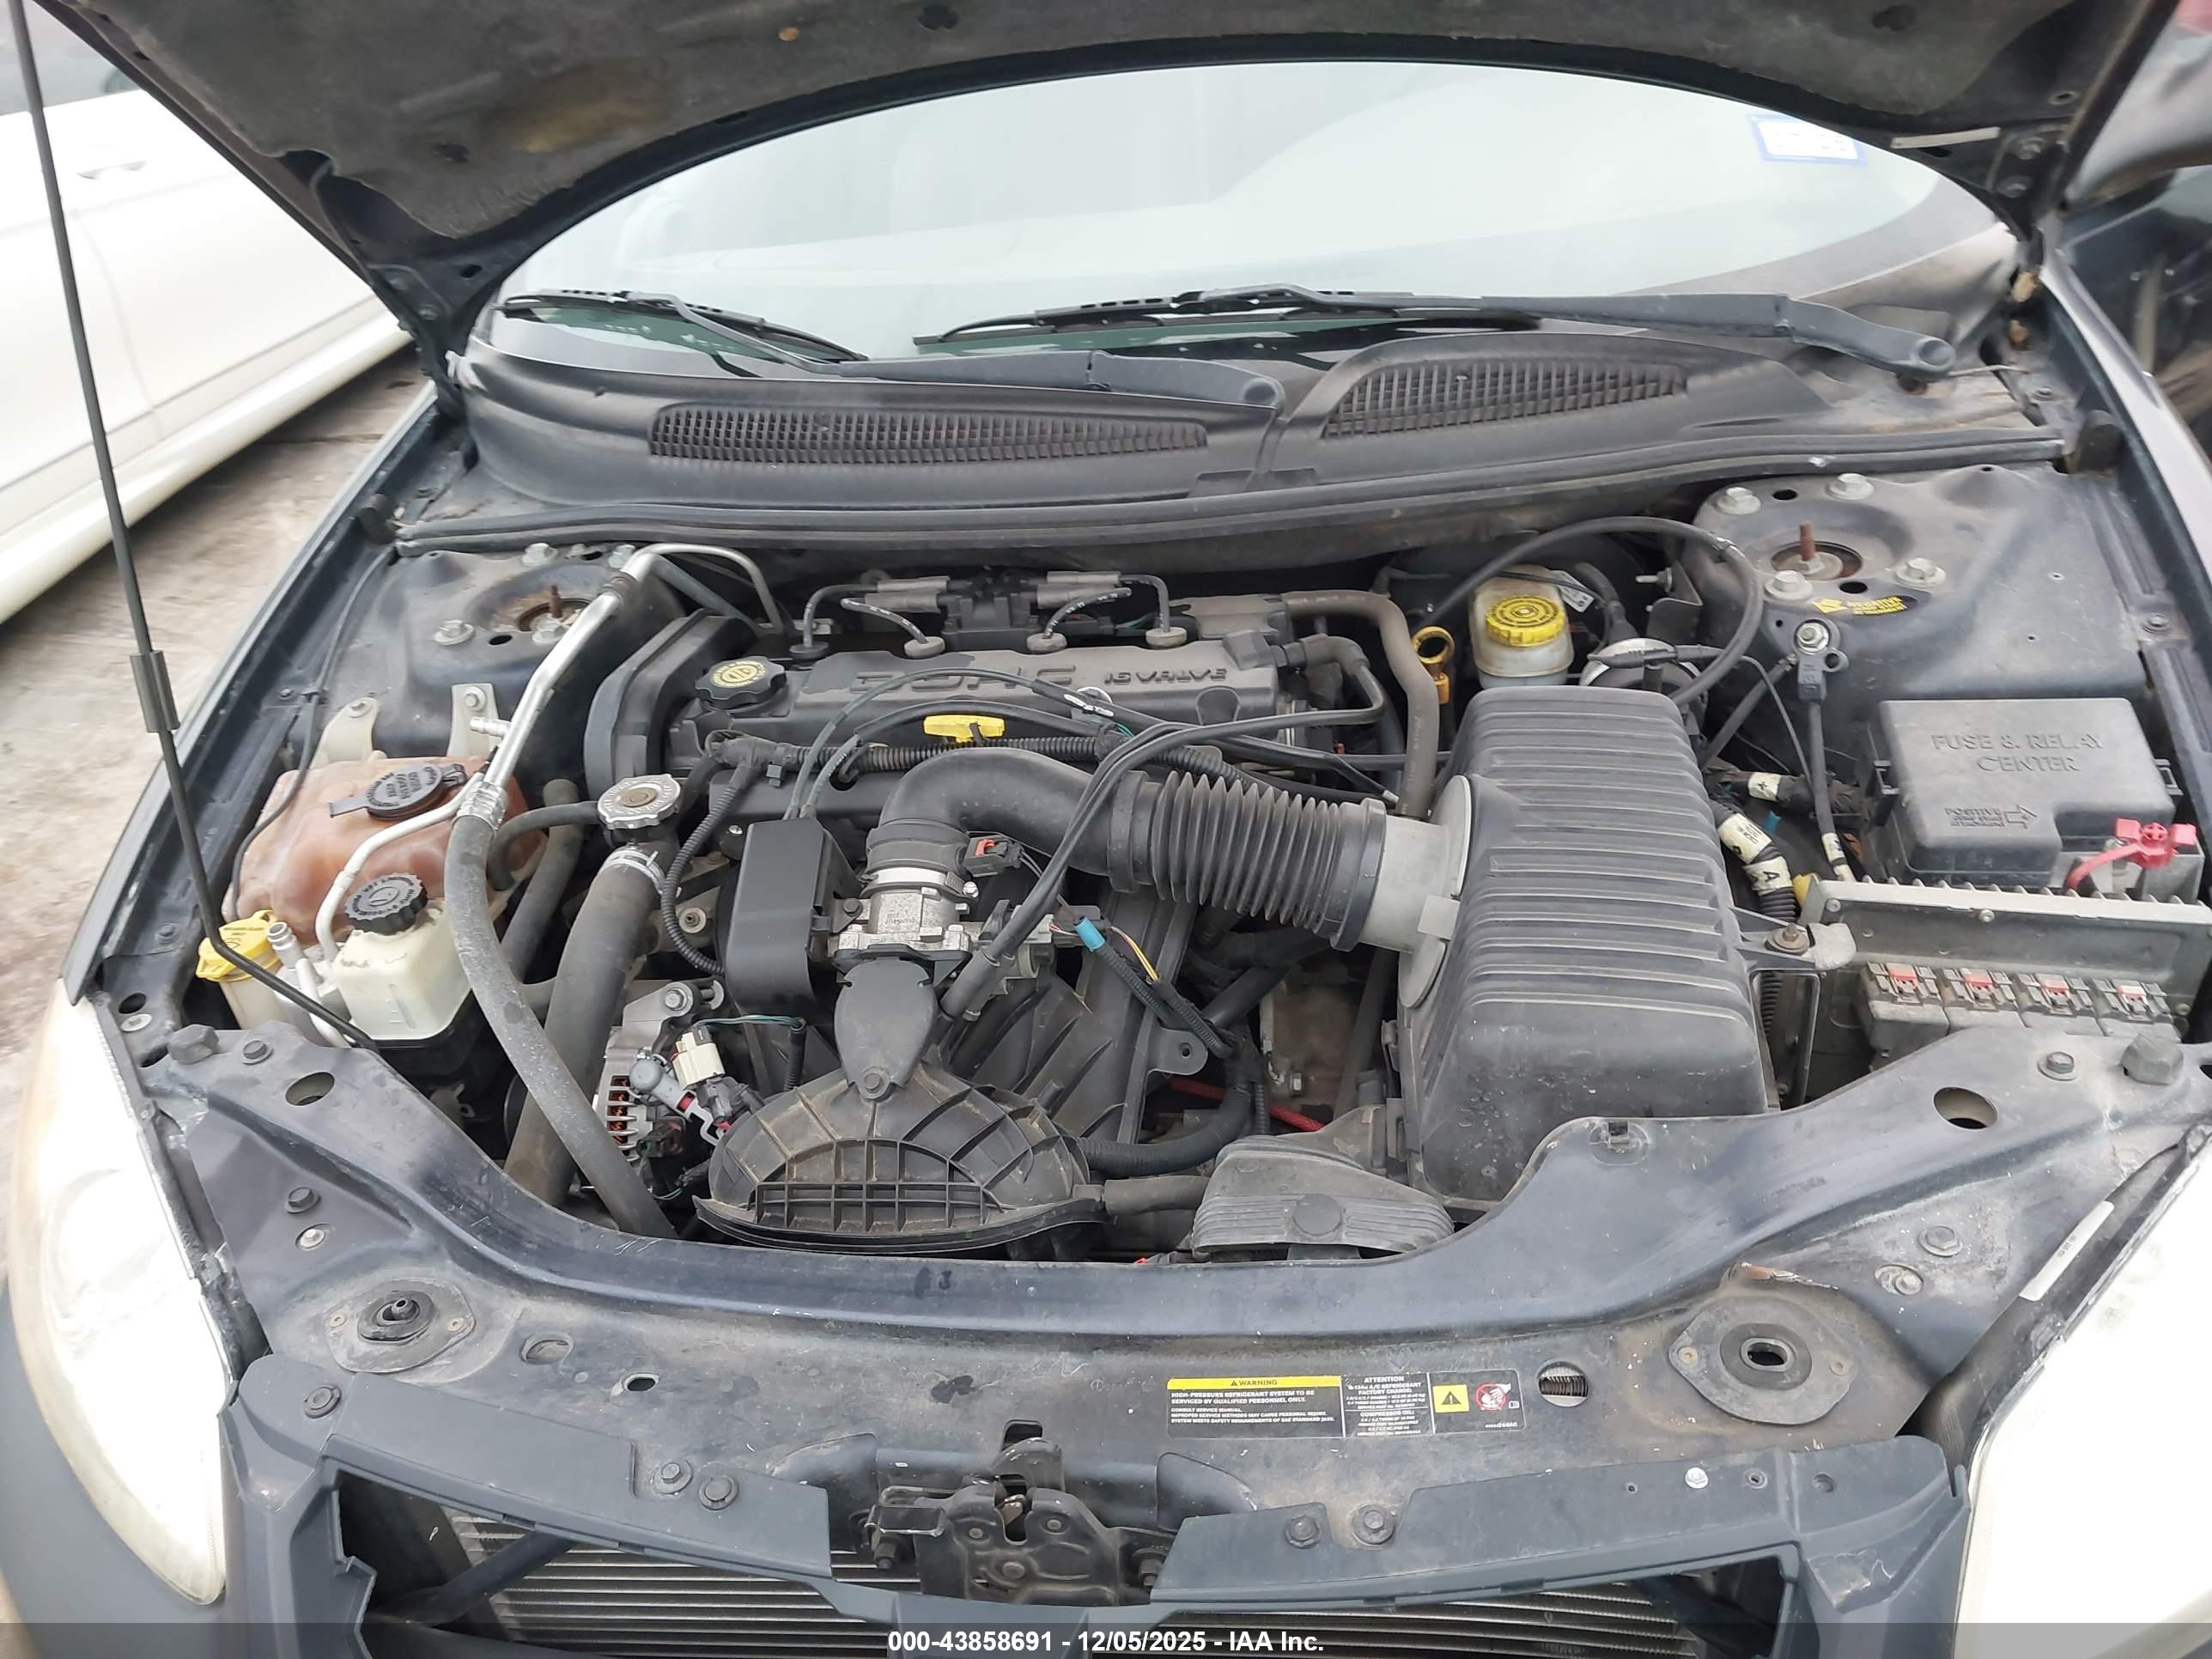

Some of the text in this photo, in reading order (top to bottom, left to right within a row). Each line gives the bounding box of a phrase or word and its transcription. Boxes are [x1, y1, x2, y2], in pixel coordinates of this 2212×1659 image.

[1136, 668, 1227, 684] VALVE
[1931, 733, 2104, 750] FUSE & RELAY
[1977, 755, 2081, 772] CENTER
